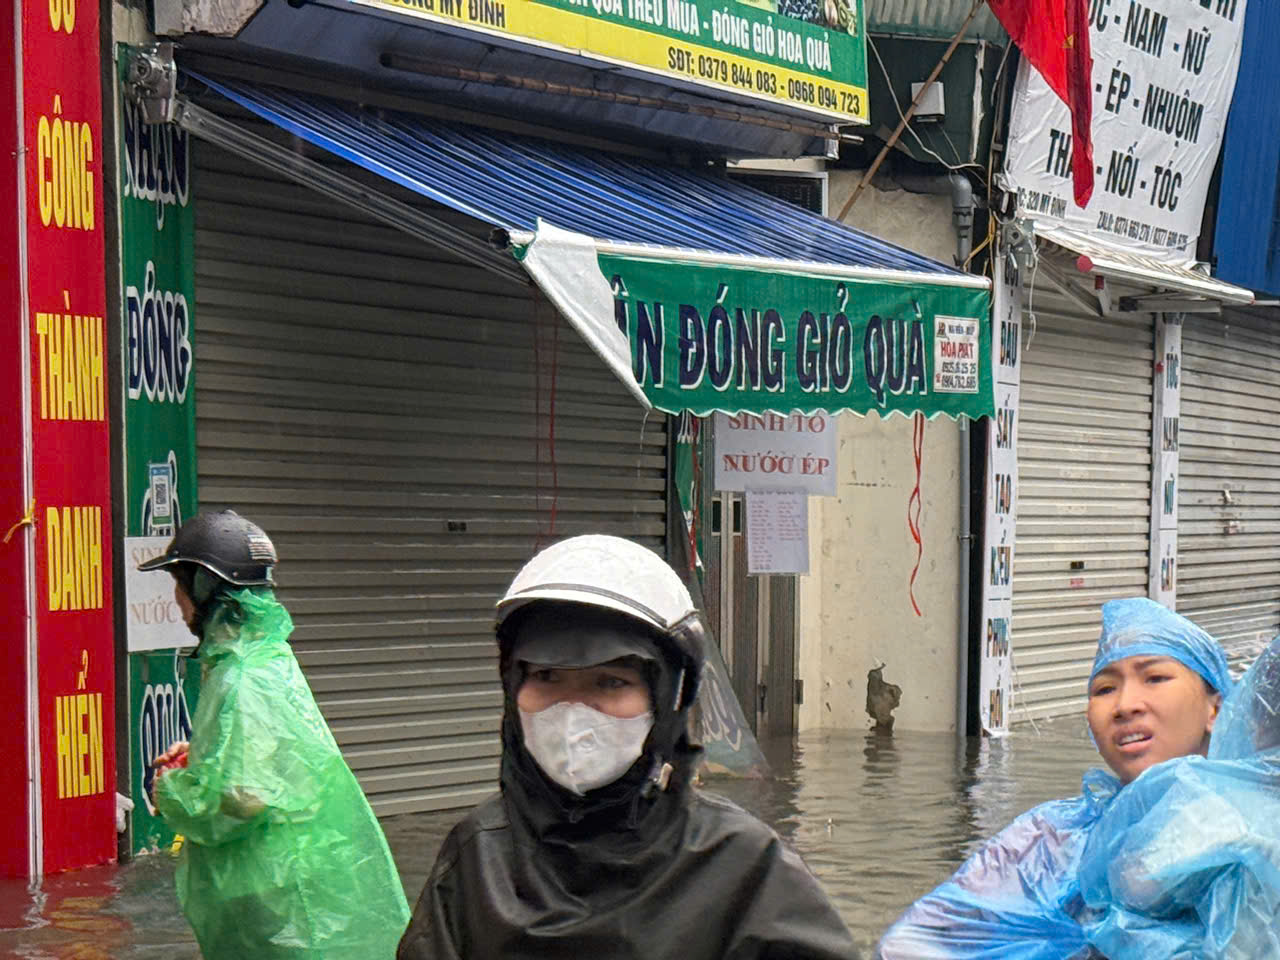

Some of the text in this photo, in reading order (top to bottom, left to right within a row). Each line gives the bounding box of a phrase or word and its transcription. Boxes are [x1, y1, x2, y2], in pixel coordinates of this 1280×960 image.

[711, 7, 749, 51] ĐÓNG
[752, 15, 776, 57] GIỎ
[777, 29, 804, 65] HOA
[806, 32, 832, 73] QUẢ
[1123, 0, 1169, 59] NAM
[1181, 26, 1212, 76] NỮ
[667, 46, 696, 75] SĐT:
[698, 53, 729, 82] 0379
[731, 64, 754, 89] 844
[756, 70, 777, 95] 083
[788, 78, 816, 106] 0968
[817, 86, 838, 110] 094
[840, 92, 861, 115] 723
[1105, 60, 1131, 115] ÉP
[1142, 82, 1205, 148] NHUỘM
[37, 94, 95, 231] CÔNG
[1104, 141, 1142, 200] NỐI
[1150, 161, 1182, 212] TÓC
[36, 290, 105, 421] THÀNH
[677, 282, 787, 394] ĐÓNG
[796, 282, 854, 394] GIỎ
[863, 298, 928, 410] QUÀ
[800, 452, 830, 476] ÉP
[46, 506, 103, 612] DANH
[130, 595, 179, 626] NƯỚC
[55, 649, 105, 800] HIỂN
